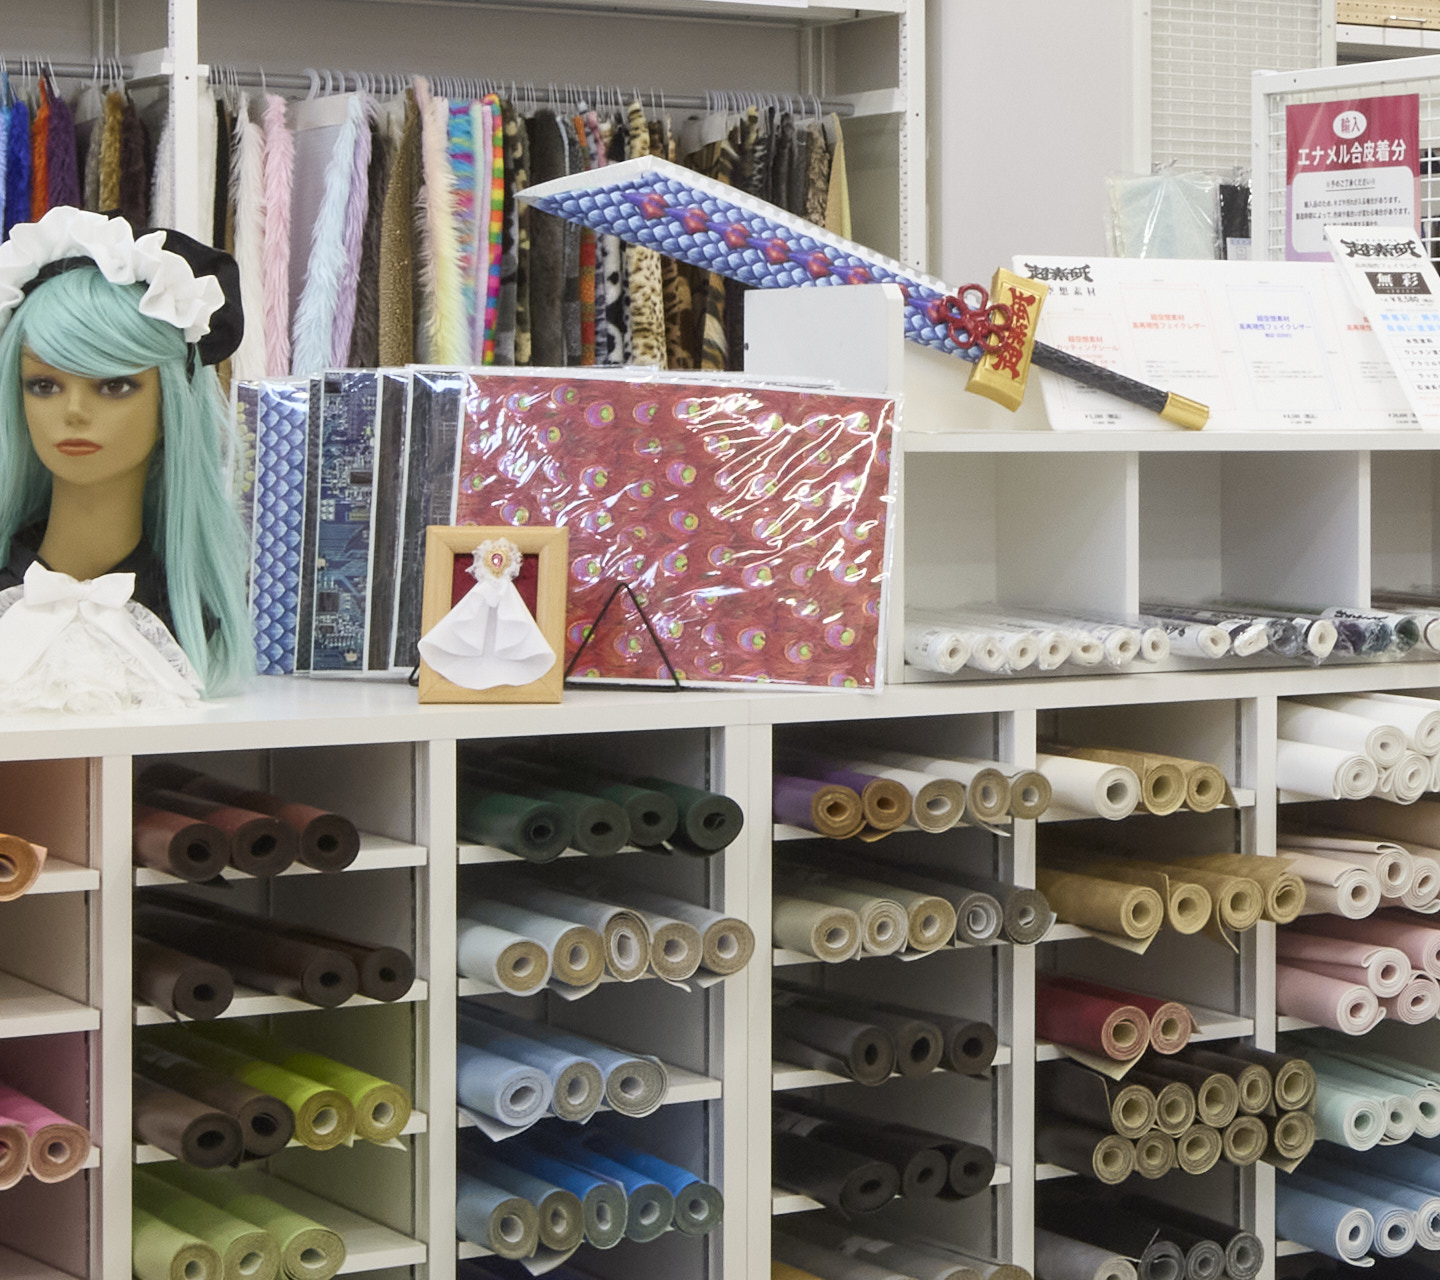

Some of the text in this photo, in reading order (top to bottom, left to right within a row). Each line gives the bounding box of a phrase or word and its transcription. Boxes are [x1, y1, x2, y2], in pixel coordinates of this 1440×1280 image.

[1298, 139, 1406, 166] エナメル合皮着分
